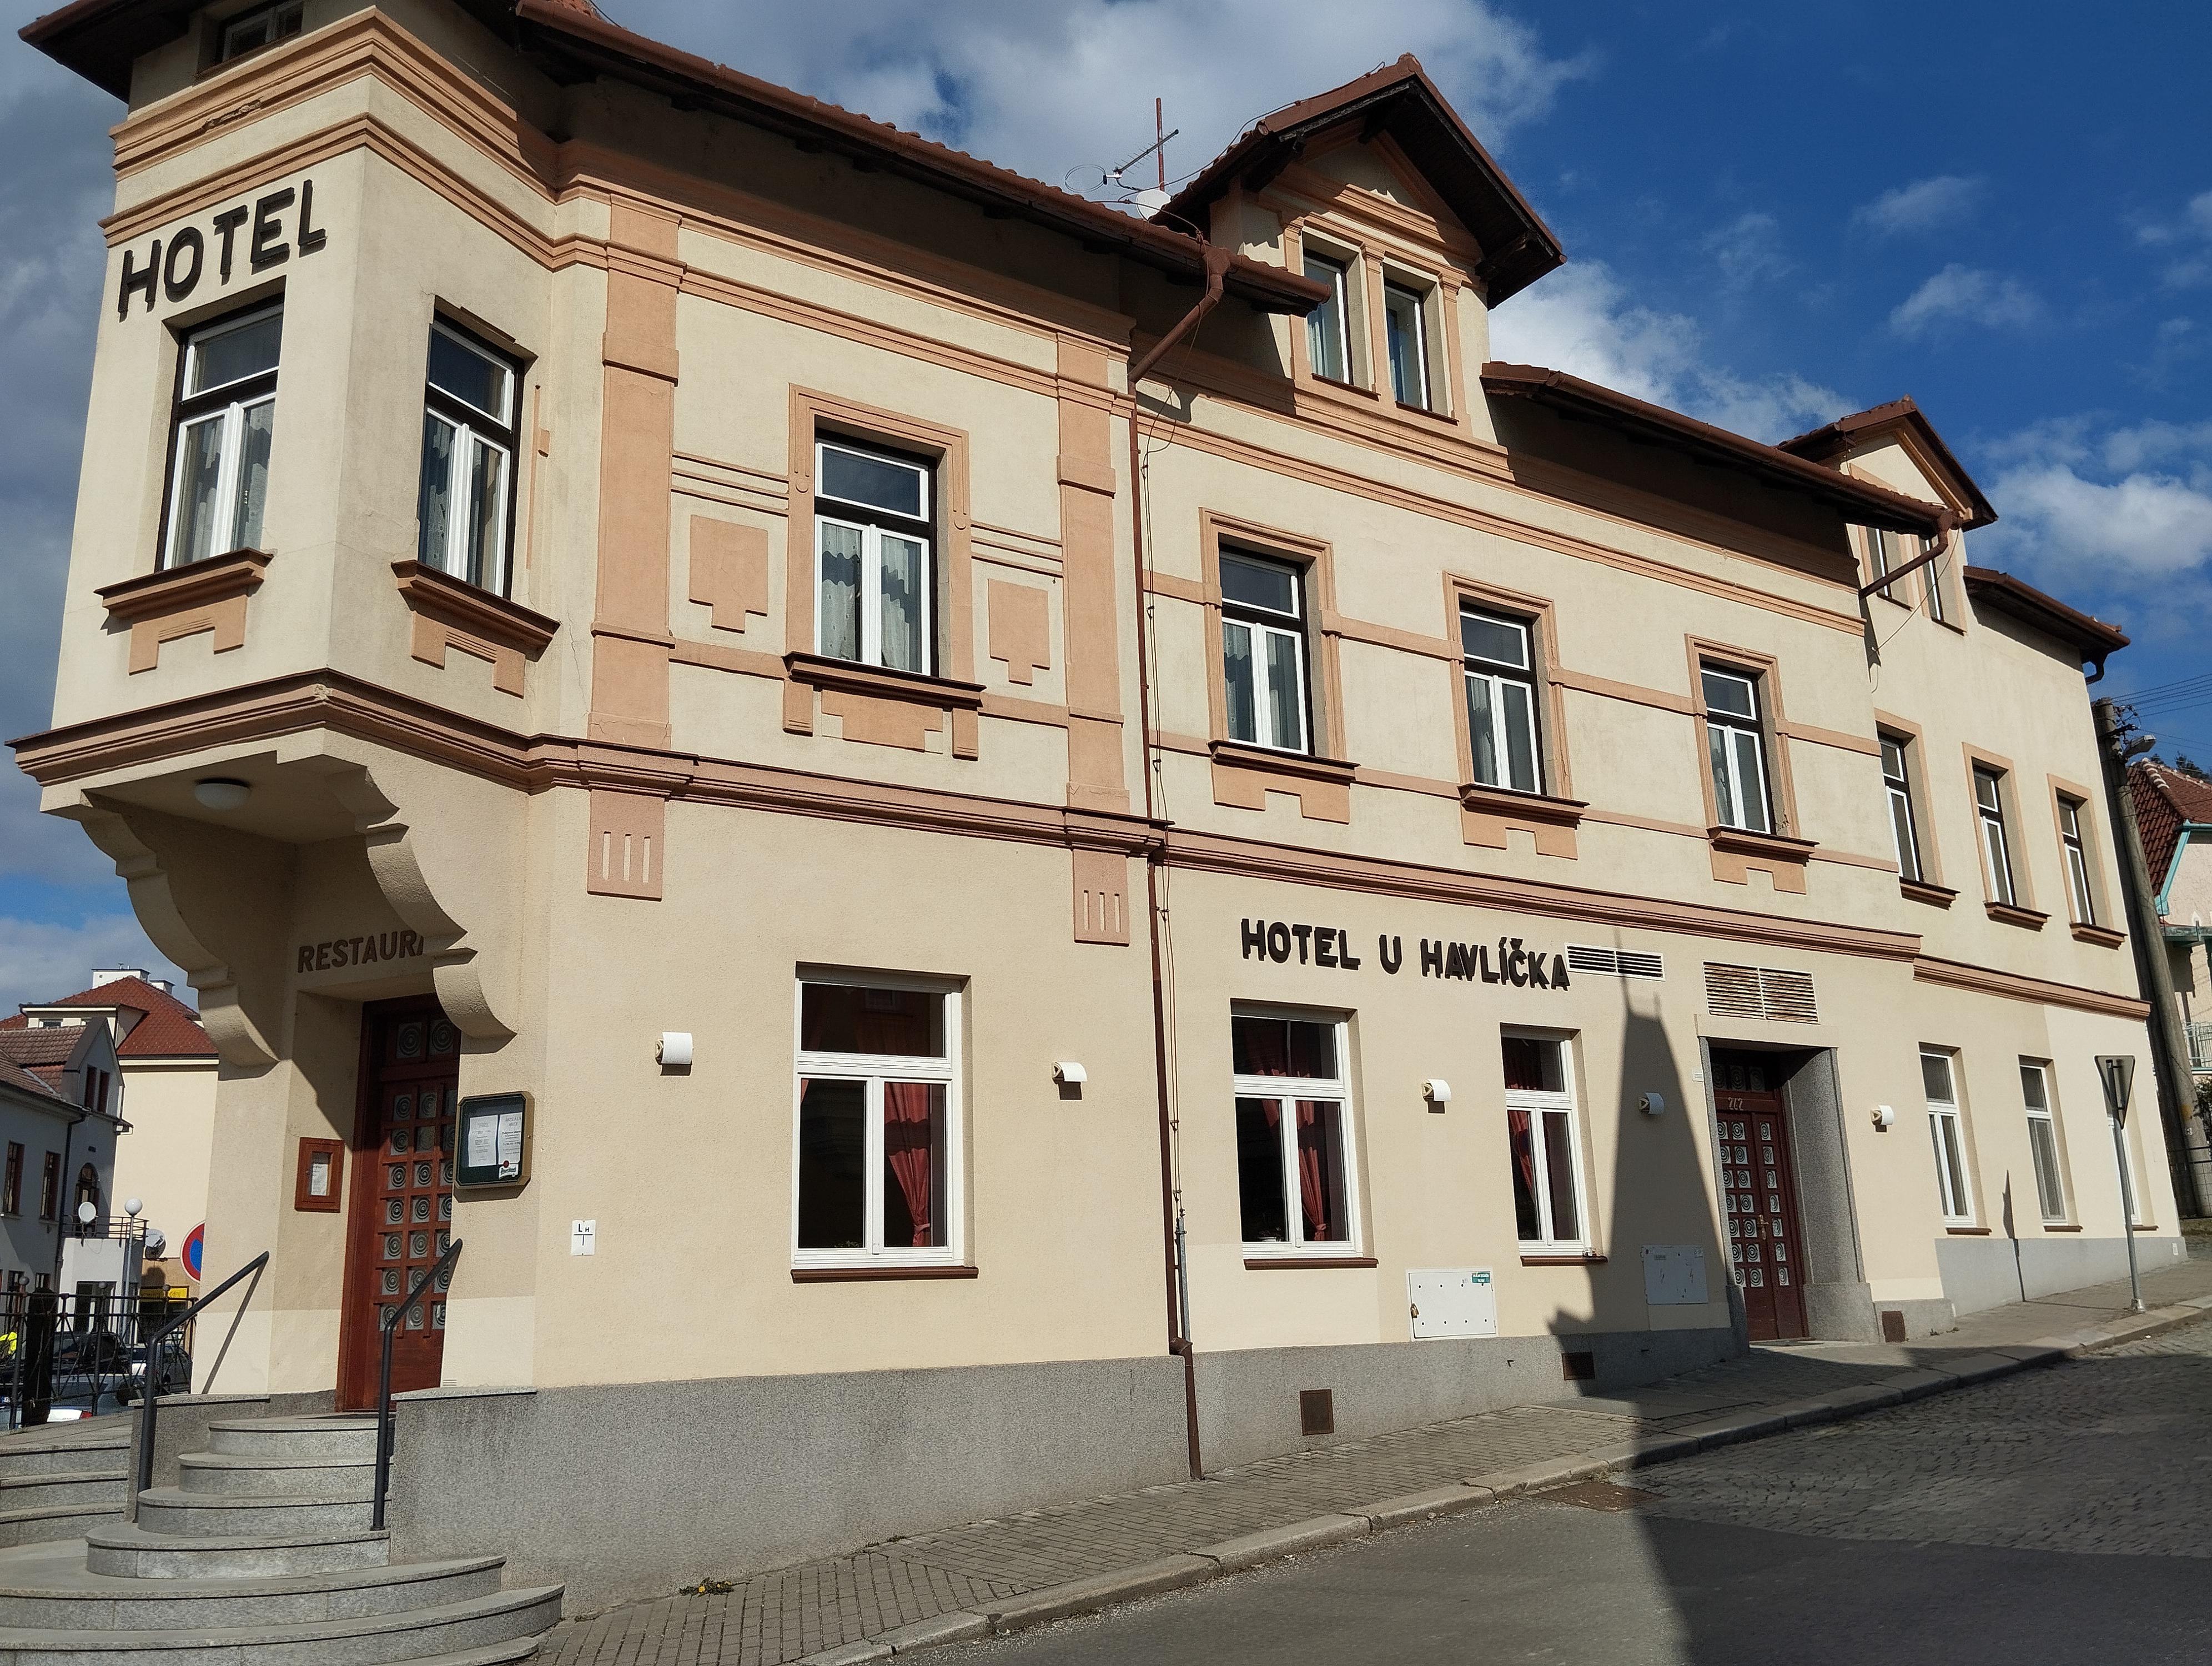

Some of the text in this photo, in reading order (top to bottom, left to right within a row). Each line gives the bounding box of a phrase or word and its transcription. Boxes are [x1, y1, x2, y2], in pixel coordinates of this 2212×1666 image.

[117, 179, 328, 321] HOTEL
[1240, 917, 1572, 991] HOTEL U HAVLÍČKA
